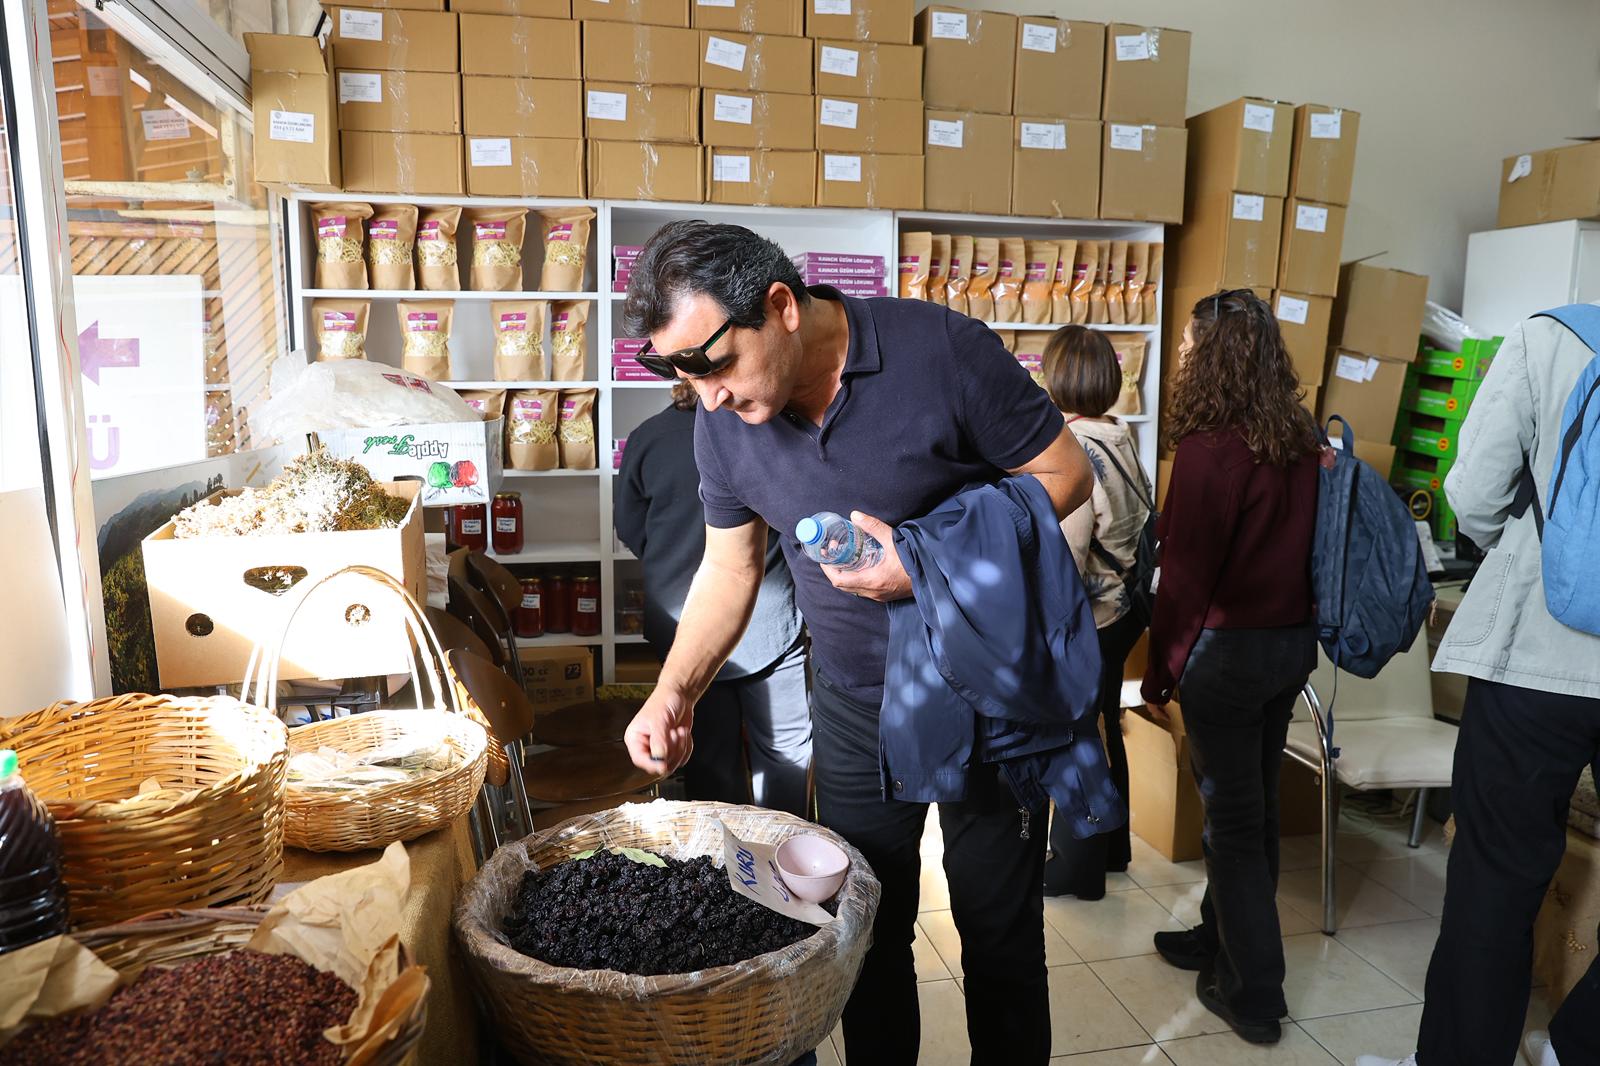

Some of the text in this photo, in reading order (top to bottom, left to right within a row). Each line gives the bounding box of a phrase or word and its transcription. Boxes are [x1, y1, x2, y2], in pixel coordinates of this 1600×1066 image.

[362, 434, 448, 460] Apple Fresh
[734, 845, 760, 896] KURU
